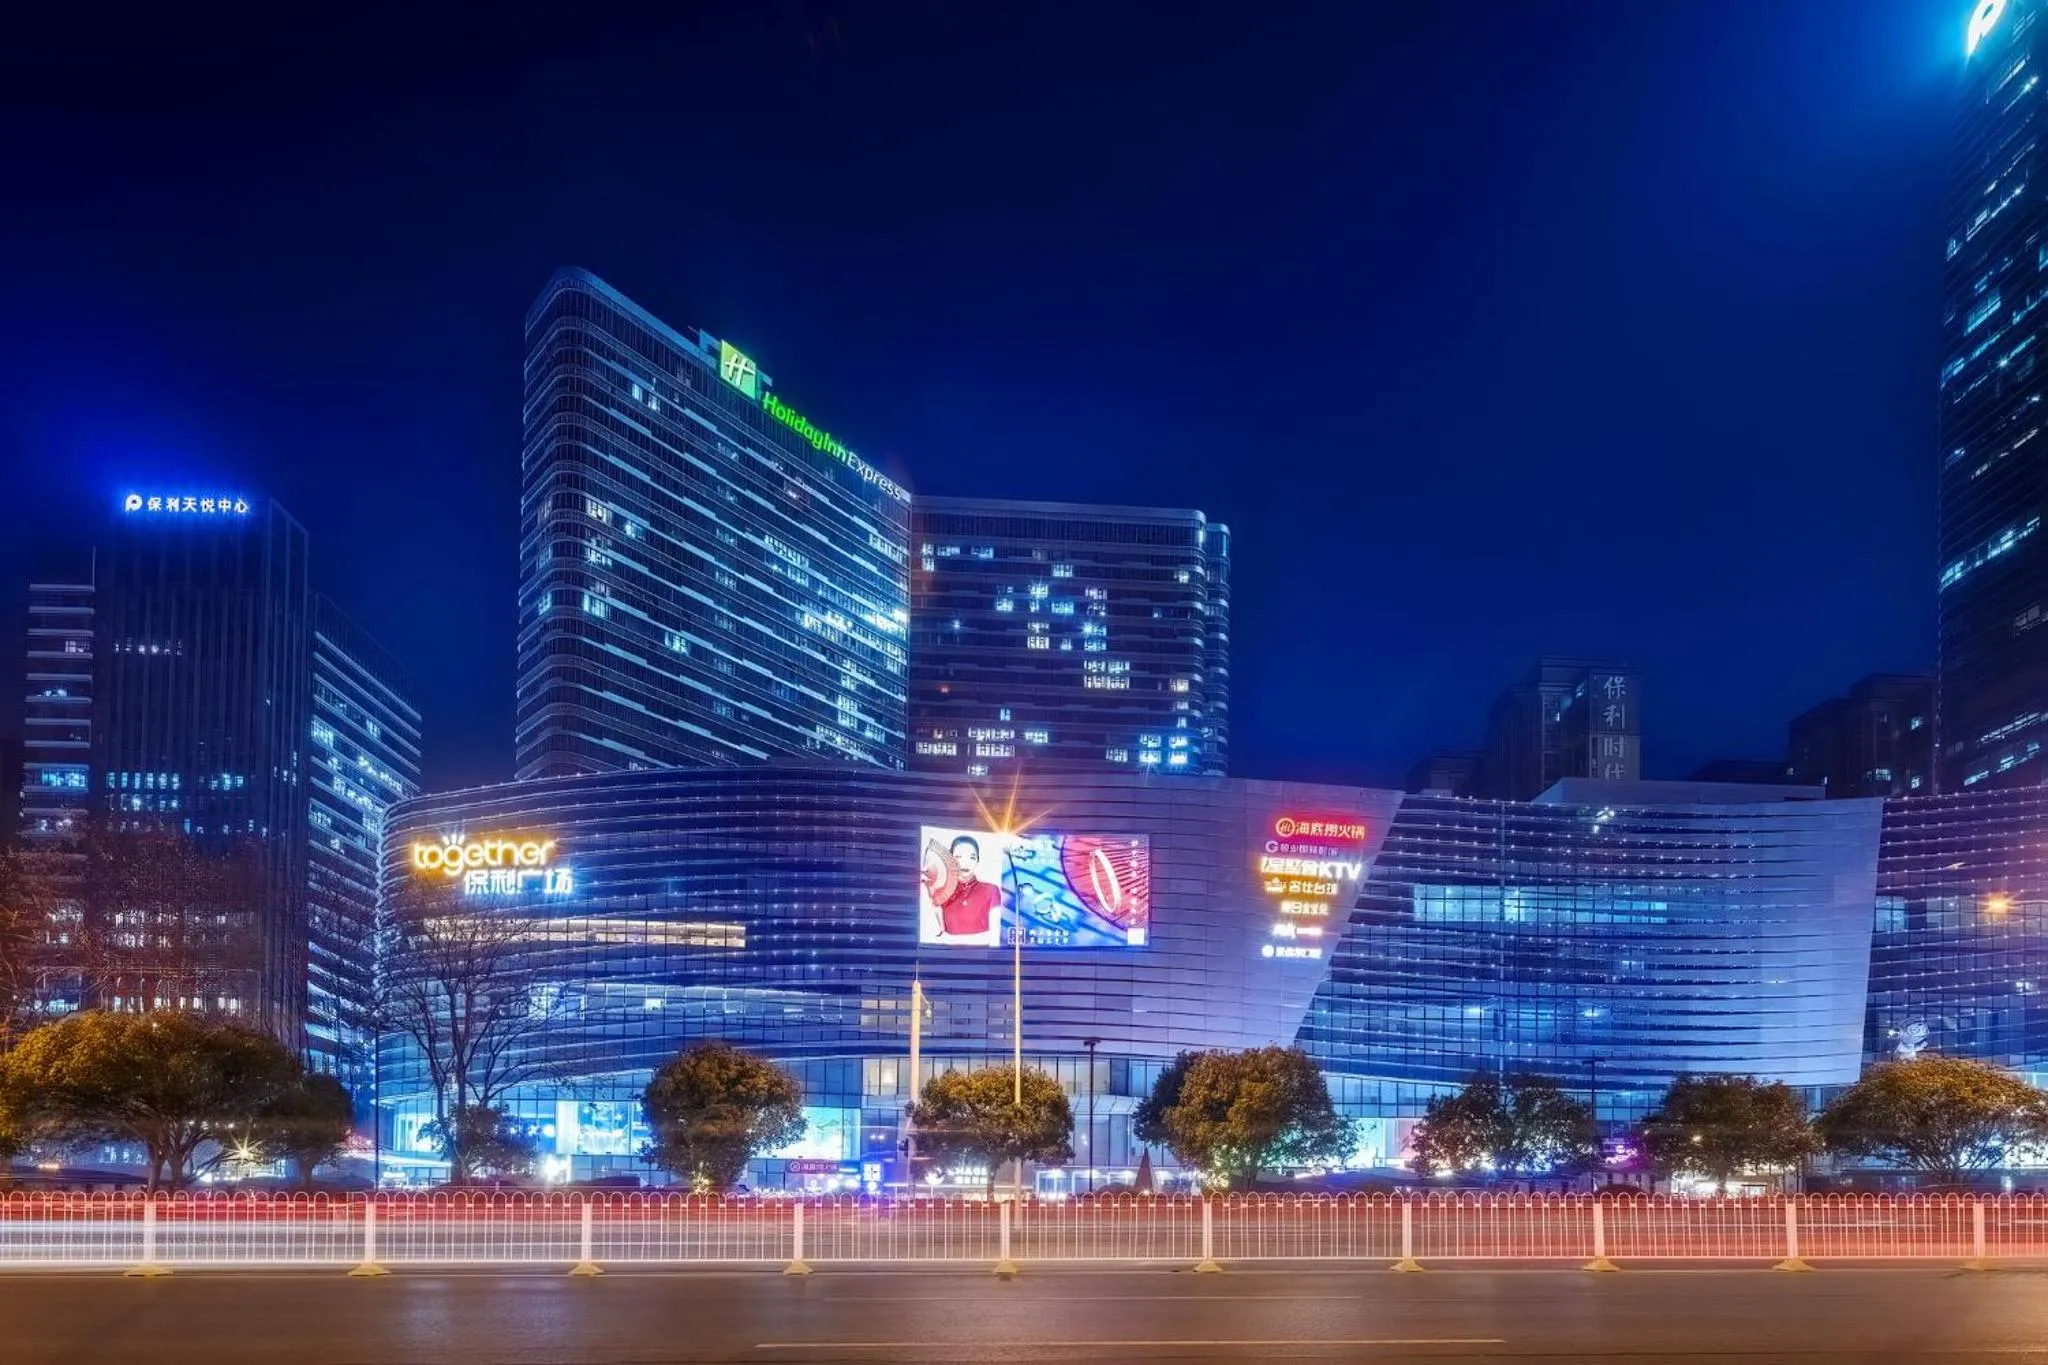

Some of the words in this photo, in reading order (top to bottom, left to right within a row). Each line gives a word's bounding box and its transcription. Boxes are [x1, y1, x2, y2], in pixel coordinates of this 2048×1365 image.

[762, 391, 824, 450] Holiday
[823, 432, 847, 463] Inn
[847, 451, 901, 501] Express
[147, 496, 249, 513] 保利天悦中心
[1603, 676, 1627, 780] 保利时代
[412, 837, 557, 876] together
[464, 867, 574, 895] 保利广场
